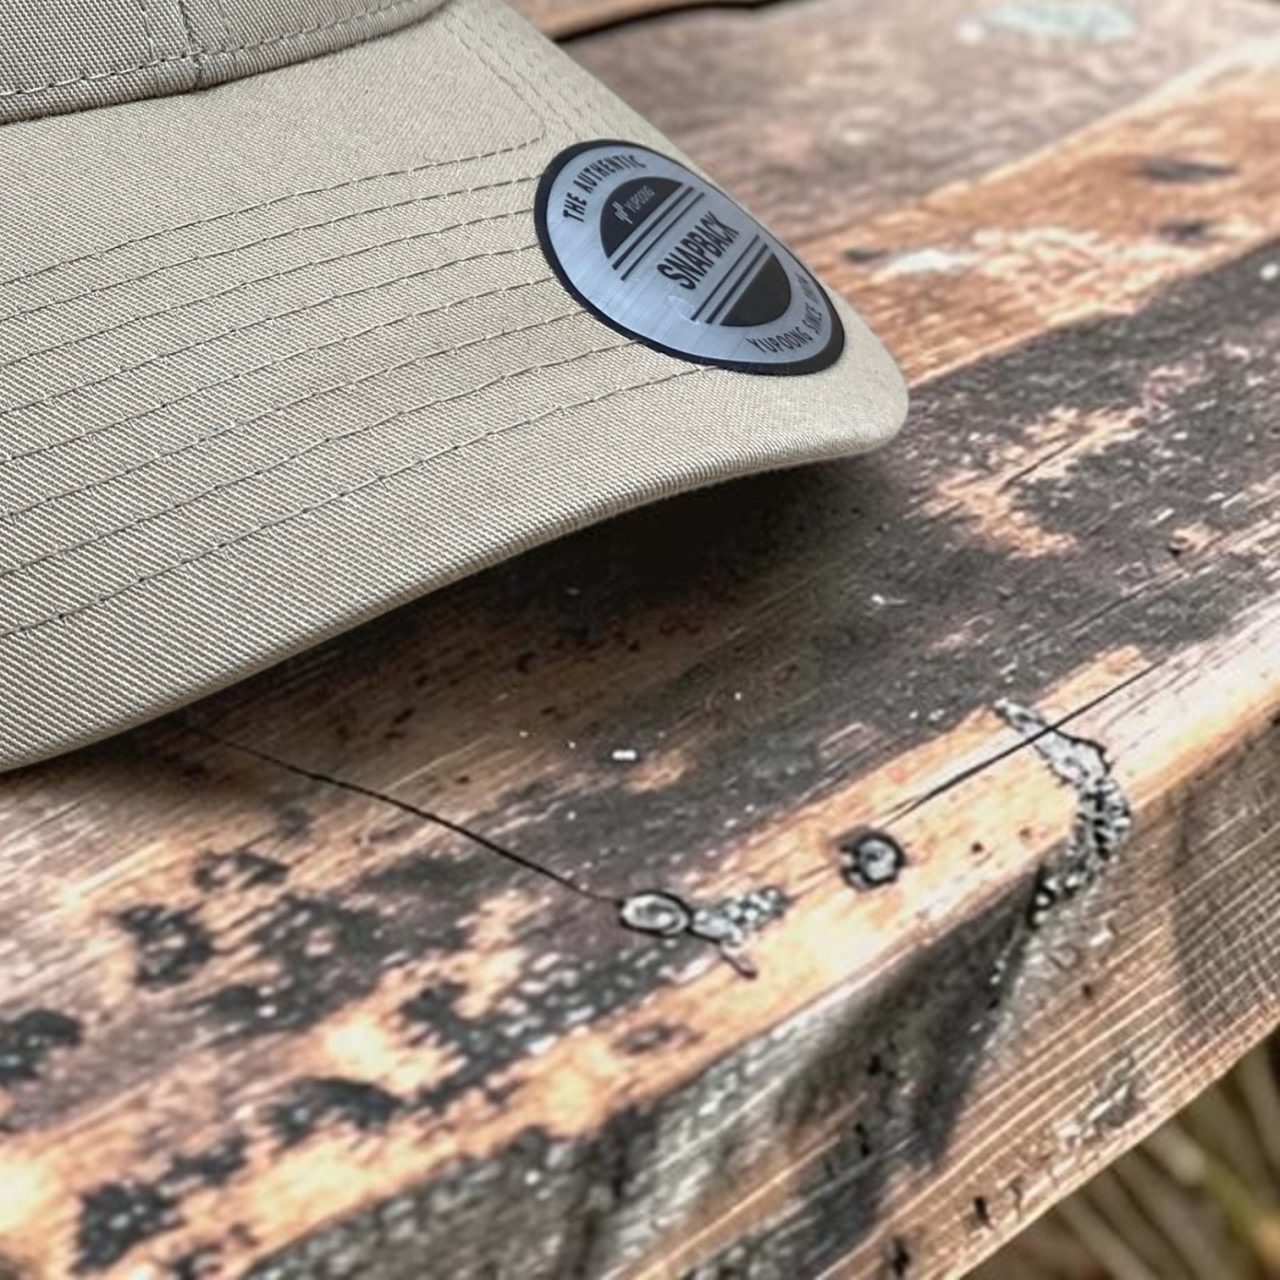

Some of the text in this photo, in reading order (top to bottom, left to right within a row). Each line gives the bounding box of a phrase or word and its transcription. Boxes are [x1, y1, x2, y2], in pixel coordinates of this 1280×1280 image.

[563, 154, 647, 222] THE AUTHENTIC
[656, 210, 740, 290] SNAPBACK
[746, 326, 813, 353] YUPOONG
